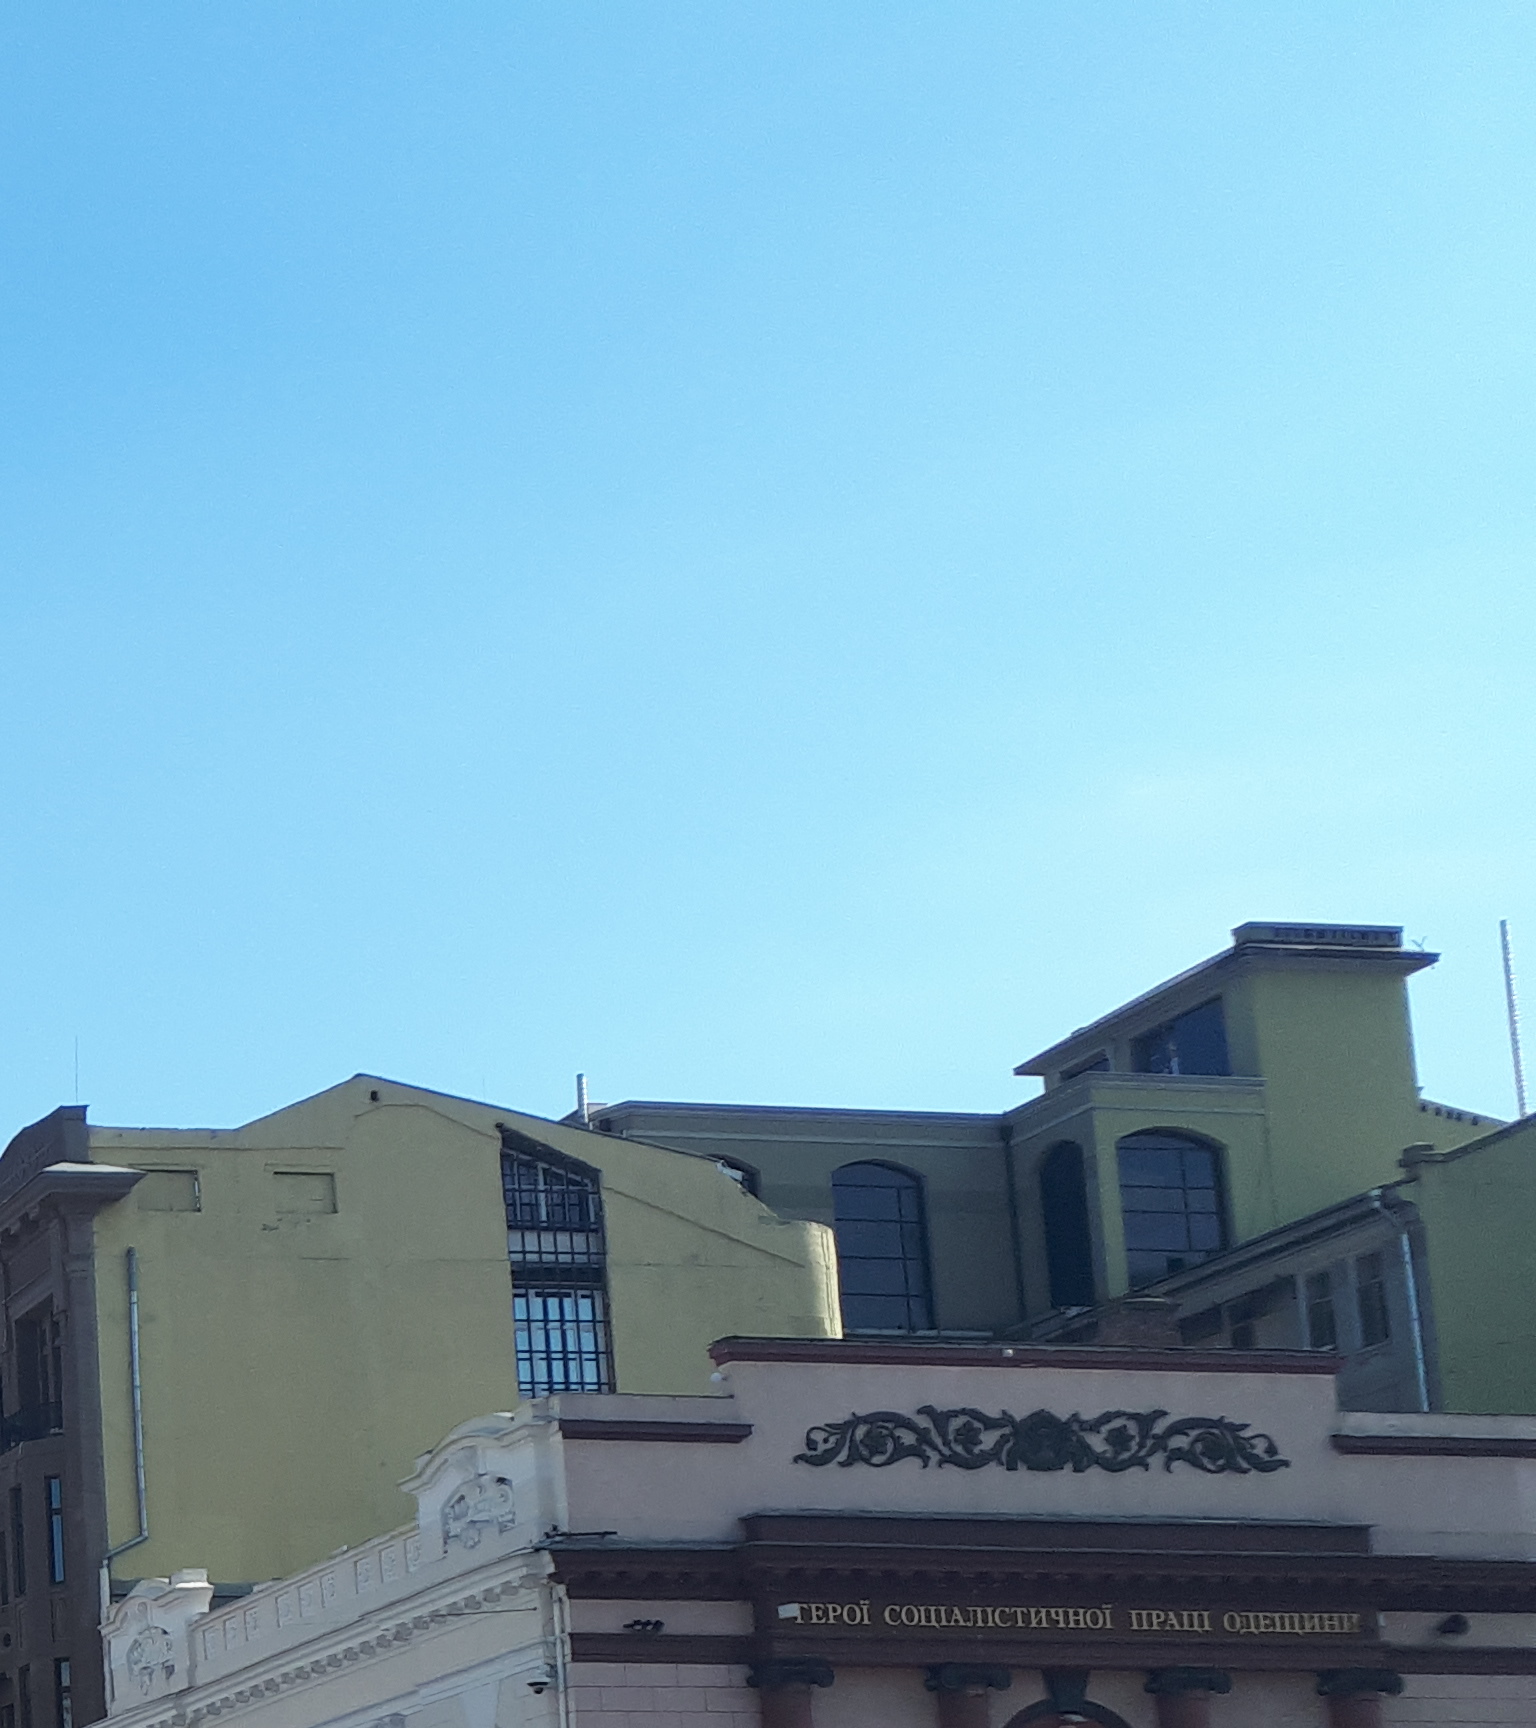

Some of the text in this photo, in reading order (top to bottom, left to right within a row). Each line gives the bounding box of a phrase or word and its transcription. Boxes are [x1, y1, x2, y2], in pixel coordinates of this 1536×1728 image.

[793, 1599, 1362, 1634] ГЕРОЇ СОЦІАЛІСТИЧНОЇ ПРАЦІ ОДЕЩИНИ
